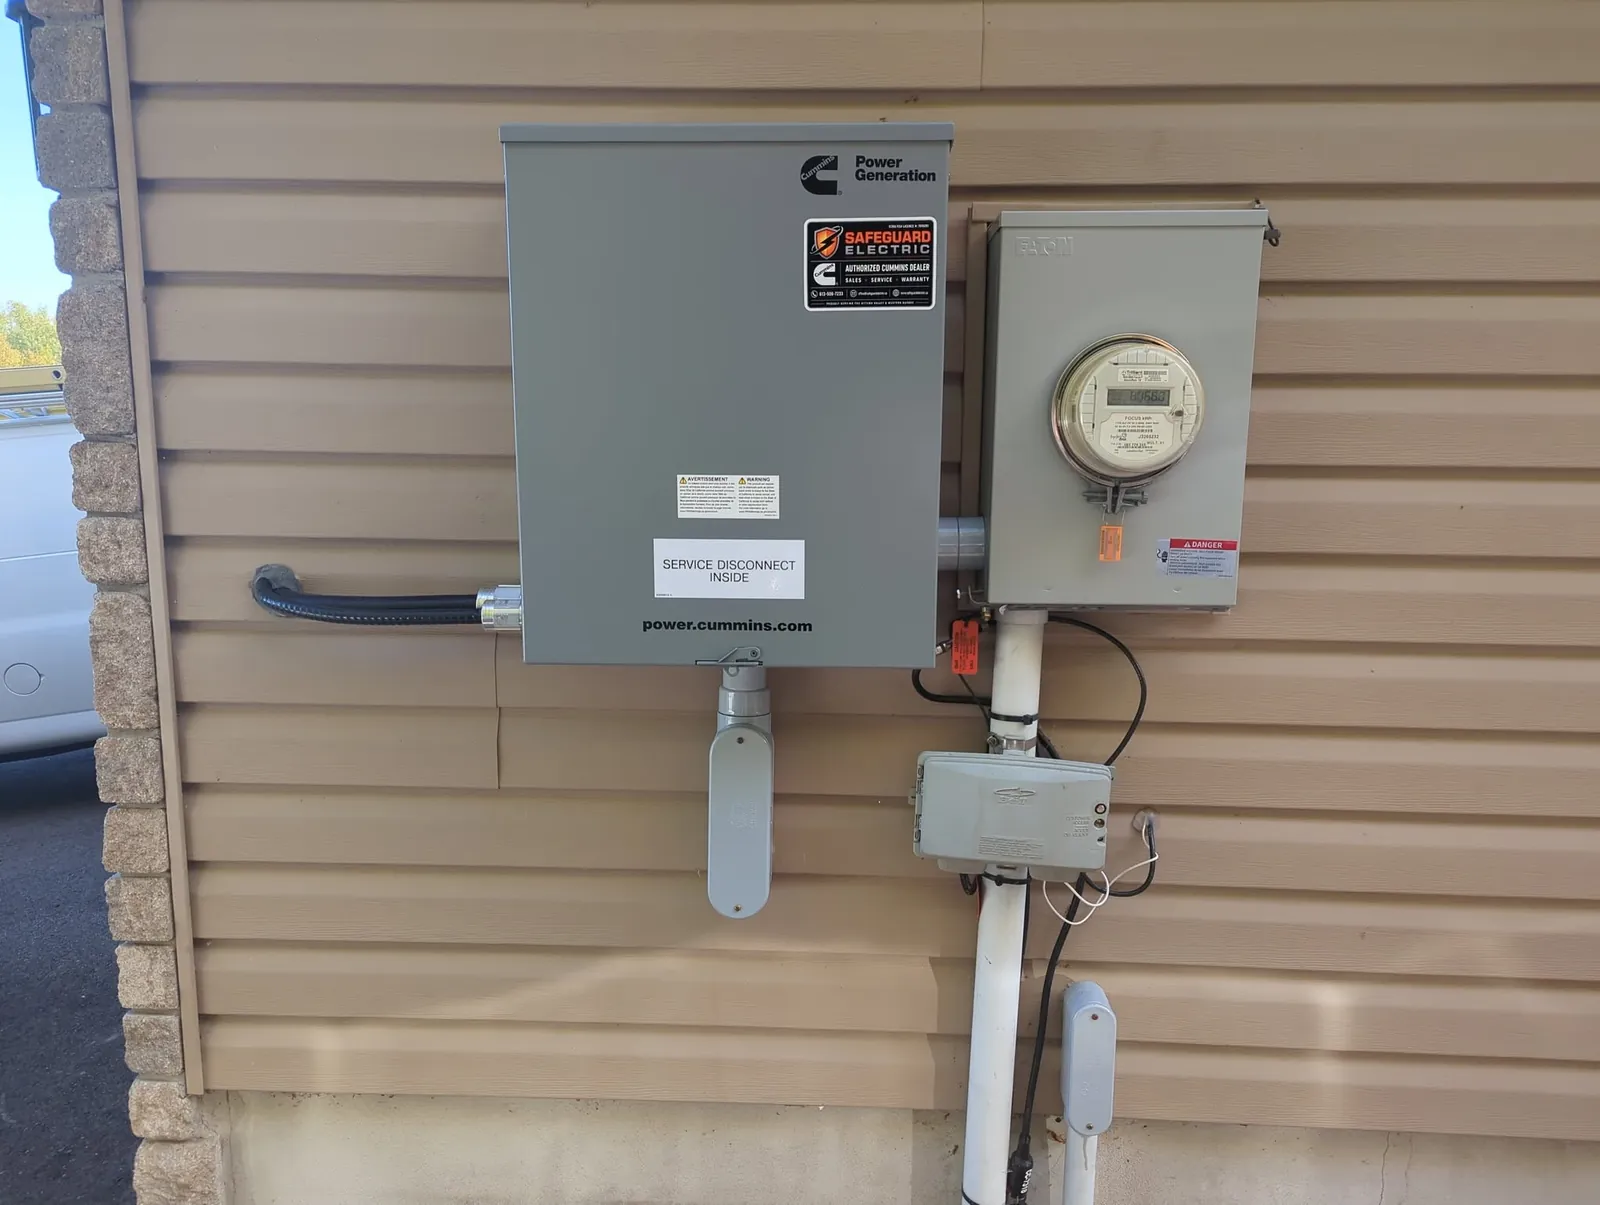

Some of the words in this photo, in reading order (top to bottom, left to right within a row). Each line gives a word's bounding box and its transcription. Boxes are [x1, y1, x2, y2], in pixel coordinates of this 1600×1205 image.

[800, 155, 836, 181] Cummins
[855, 155, 903, 168] Power
[855, 169, 936, 182] Generation
[844, 231, 932, 244] SAFEGUARD
[845, 244, 930, 255] ELECTRIC
[1015, 236, 1074, 256] EATON
[845, 264, 881, 273] AUTHORIZED
[881, 263, 909, 272] CUMMINS
[909, 263, 930, 272] DEALER
[1191, 541, 1224, 549] DANGER
[663, 558, 713, 571] SERVICE
[717, 559, 796, 571] DISCONNECT
[709, 572, 750, 583] INSIDE
[642, 619, 813, 633] power.cummins.com
